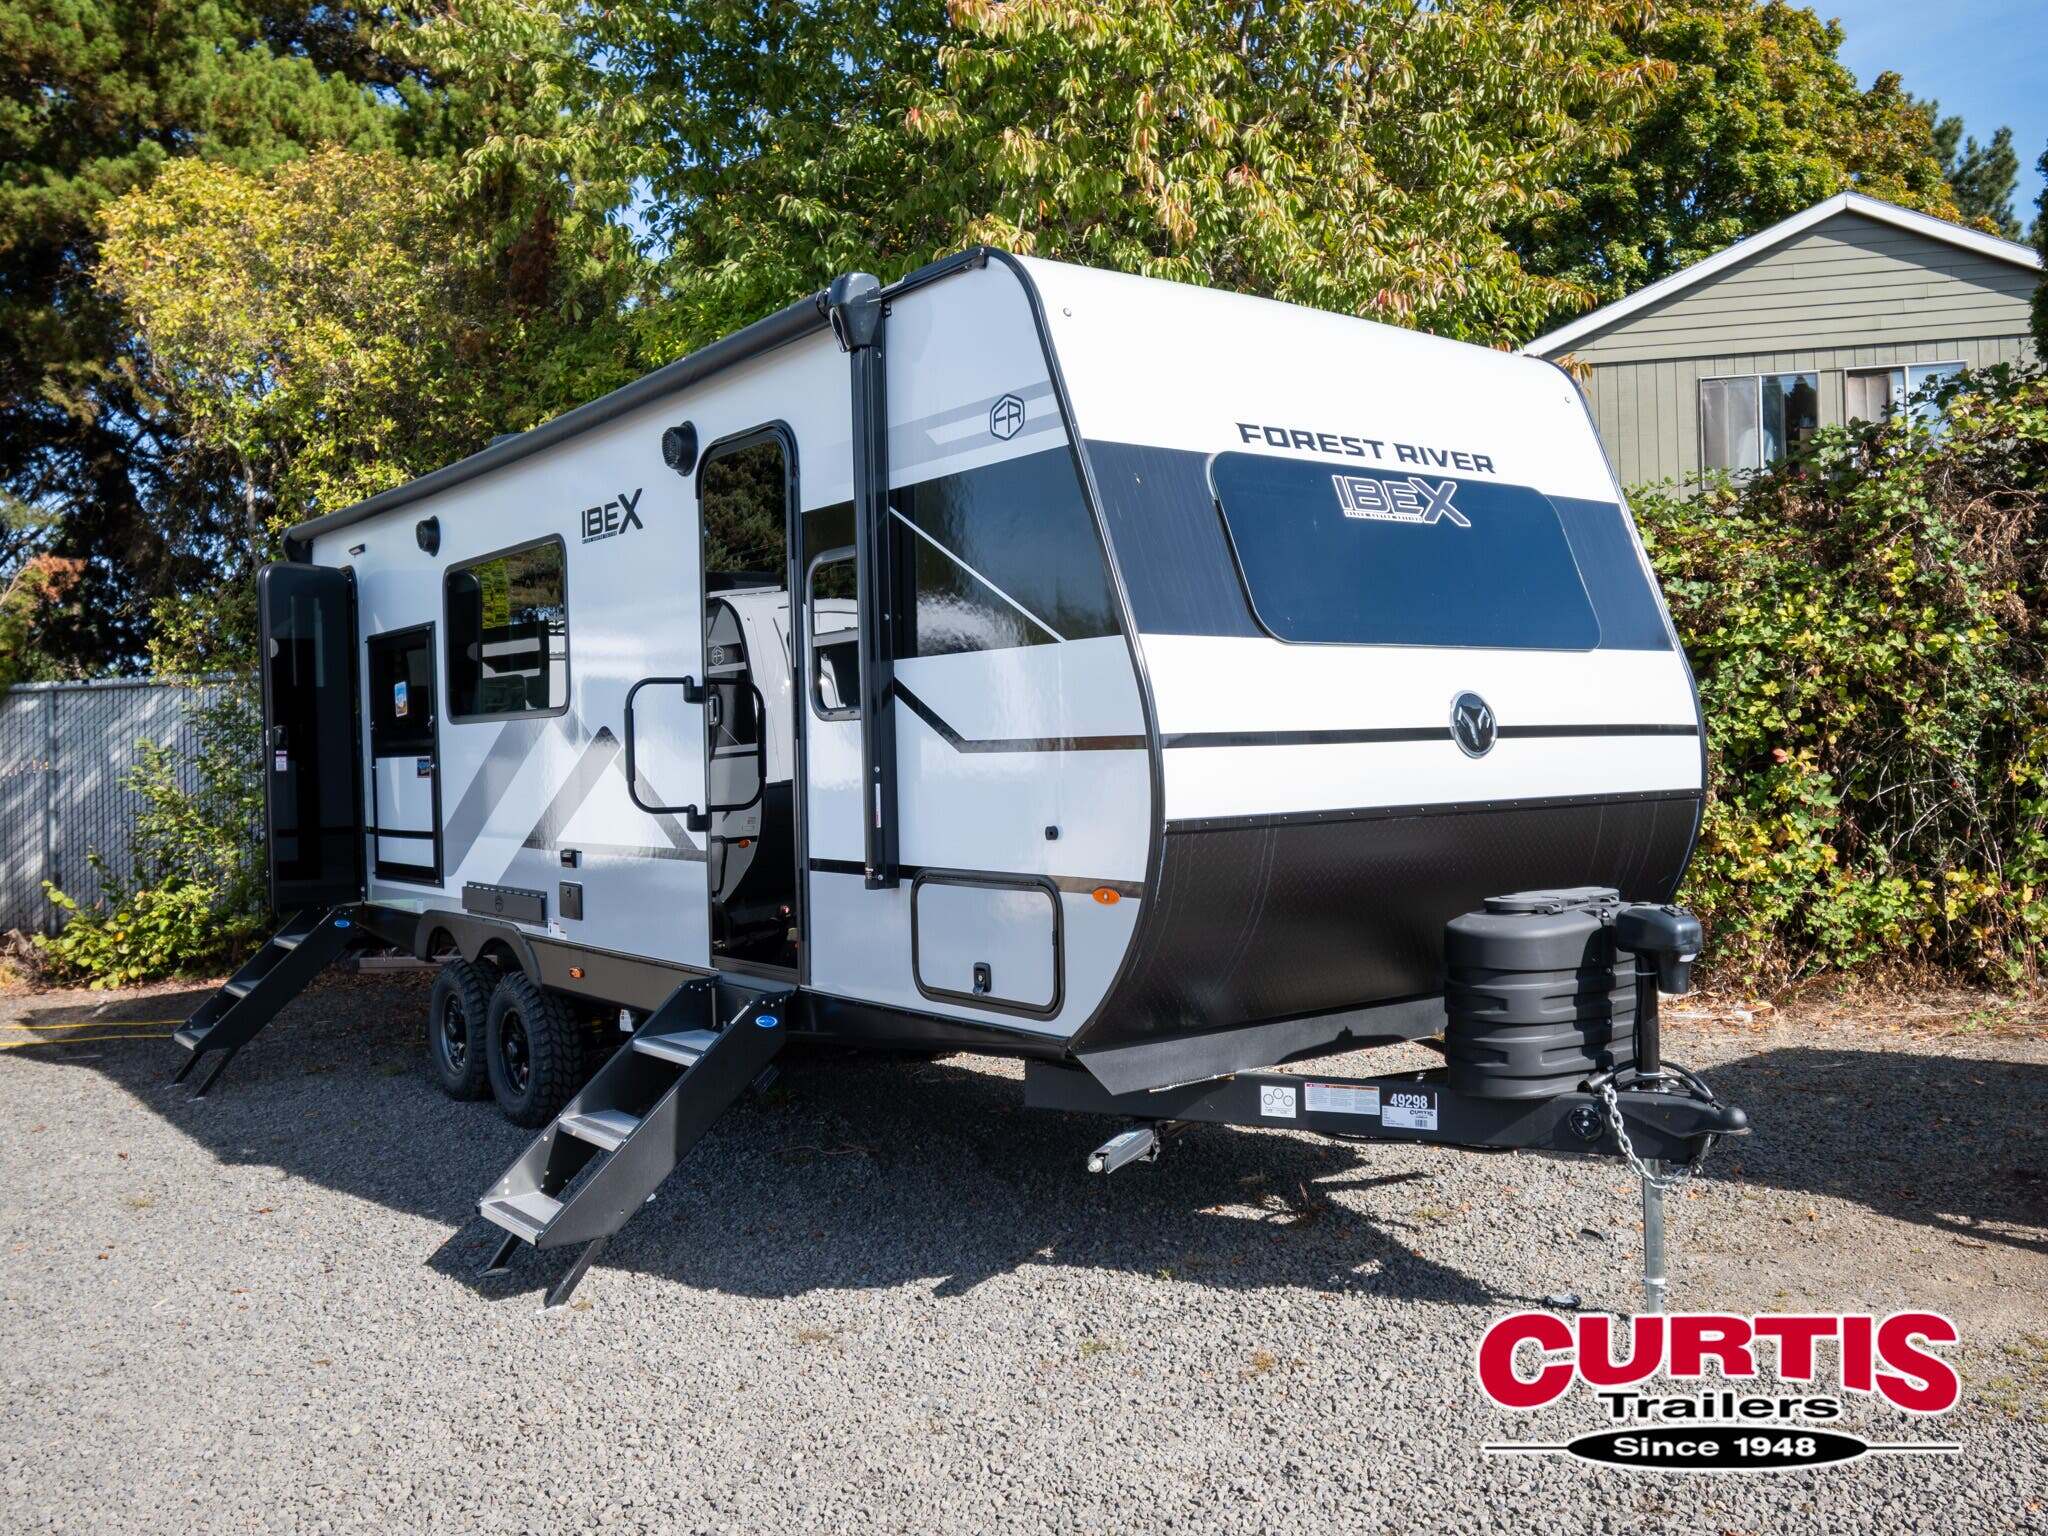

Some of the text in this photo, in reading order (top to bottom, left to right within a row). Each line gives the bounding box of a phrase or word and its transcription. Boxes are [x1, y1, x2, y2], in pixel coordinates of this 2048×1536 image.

[1235, 422, 1496, 473] FOREST RIVER
[582, 487, 643, 538] IBEX
[1331, 475, 1472, 528] IBEX
[1390, 1093, 1428, 1109] 49298
